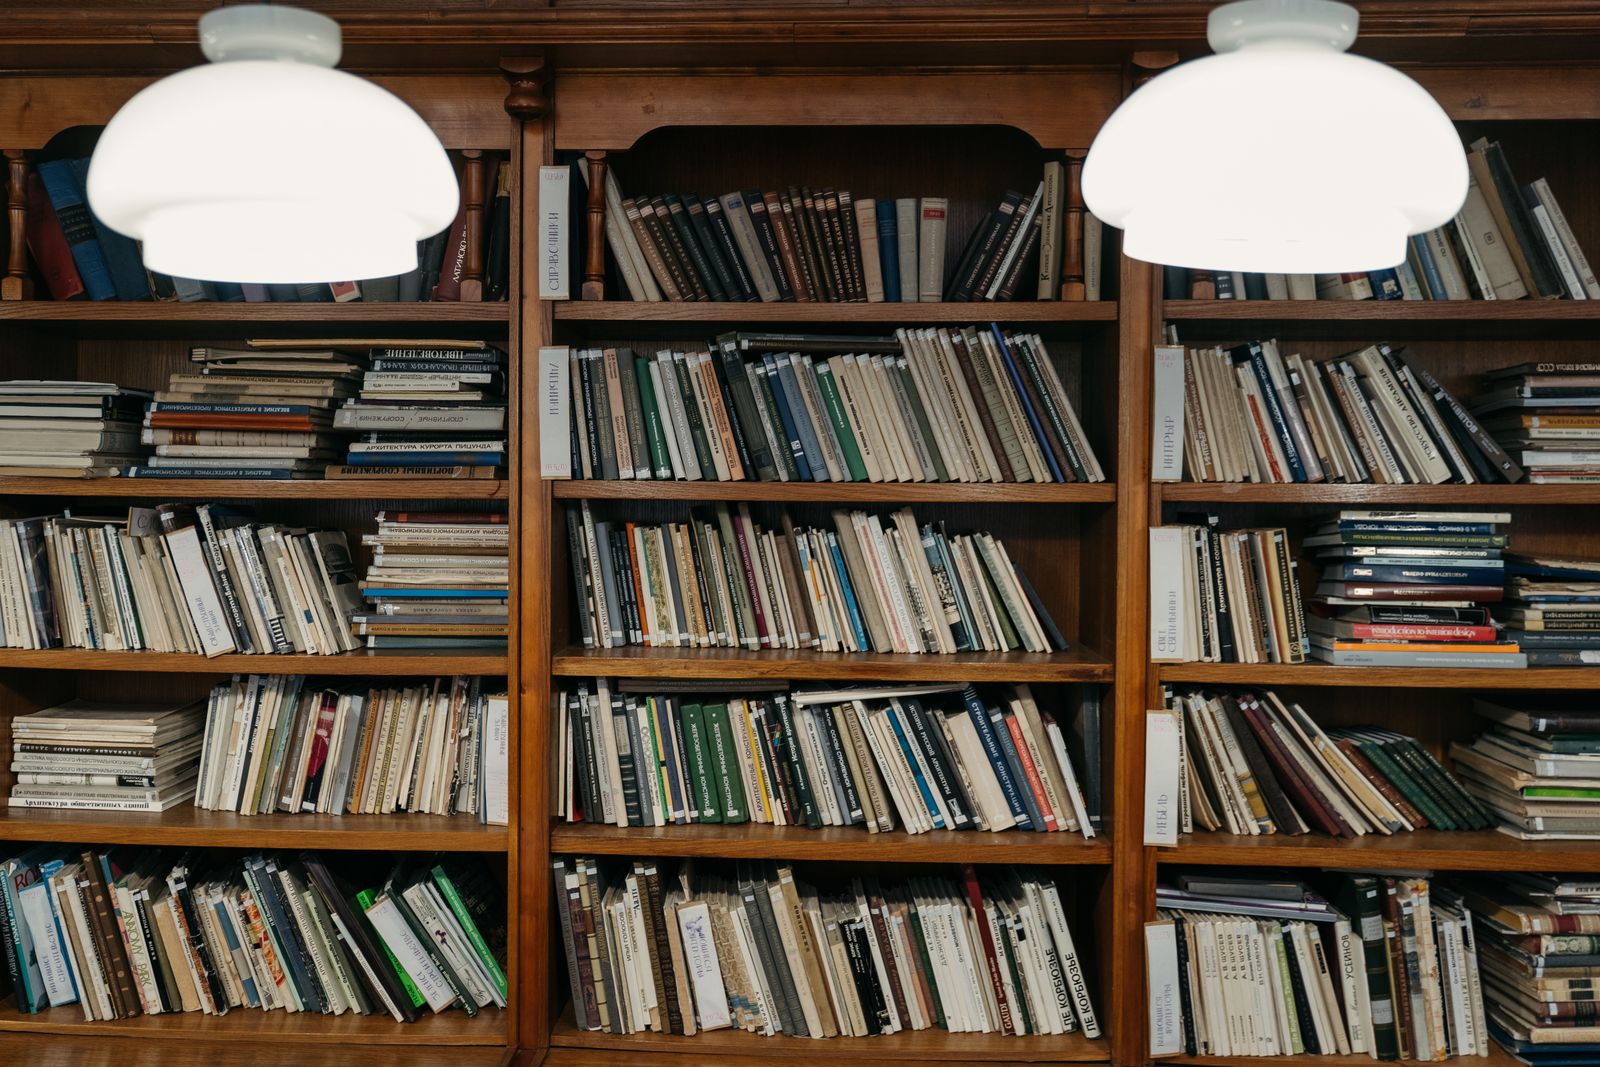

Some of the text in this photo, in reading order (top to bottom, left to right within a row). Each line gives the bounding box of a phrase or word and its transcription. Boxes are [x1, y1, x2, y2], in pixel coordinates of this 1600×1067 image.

[548, 212, 559, 290] СПРАВОЧНИКИ
[1377, 367, 1409, 414] АНСАМБЛЯ
[1197, 429, 1212, 465] ИНТЕРЬЕР
[1215, 568, 1226, 613] Архитектура
[690, 723, 712, 814] ЖЕЛЕЗОБЕТОННЫЕ КОНСТРУКЦ
[713, 722, 735, 814] ЖЕЛЕЗОБЕТОННЫЕ КОНСТРУКЦ
[787, 737, 798, 762] История
[908, 704, 952, 796] ИСТОРИЯ РУССКОЙ АРХИТЕКТУРЫ
[971, 701, 1022, 814] СТРОИТЕЛЬНЫЕ КОНСТРУКЦИИ
[24, 800, 67, 808] Архитектура
[122, 909, 144, 957] ANATOMY
[137, 963, 152, 987] PARK
[1044, 947, 1068, 1009] КОРБЮЗЬЕ
[1340, 934, 1355, 980] УСЕЙНОВ
[1064, 952, 1091, 1014] КОРБЮЗЬЕ
[999, 1002, 1013, 1030] GAUDI
